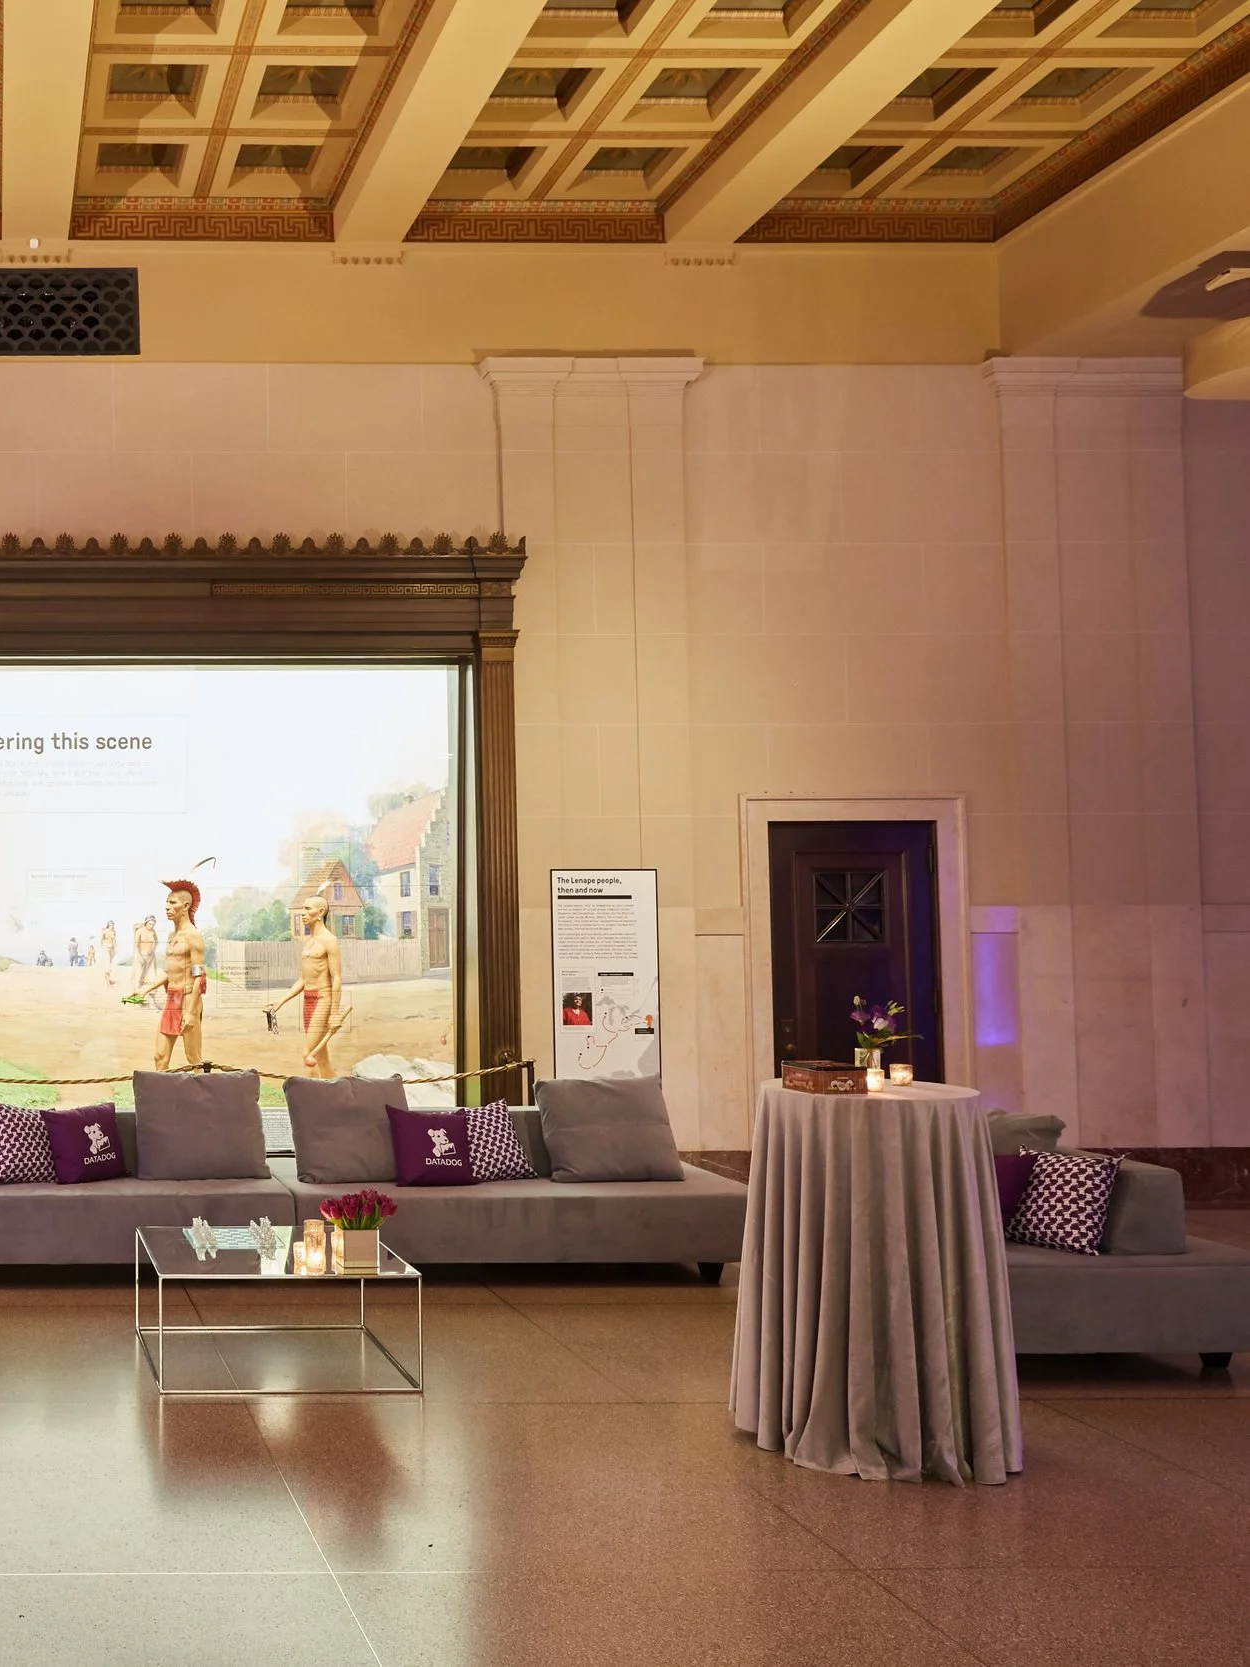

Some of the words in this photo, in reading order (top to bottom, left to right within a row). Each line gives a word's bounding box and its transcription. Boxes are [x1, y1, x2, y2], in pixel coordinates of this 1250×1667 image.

[51, 732, 89, 750] this
[95, 737, 153, 750] scene
[571, 877, 596, 885] Lenape
[597, 877, 622, 885] people,
[84, 1152, 116, 1165] DATADOG
[425, 1158, 463, 1167] DATADOG
